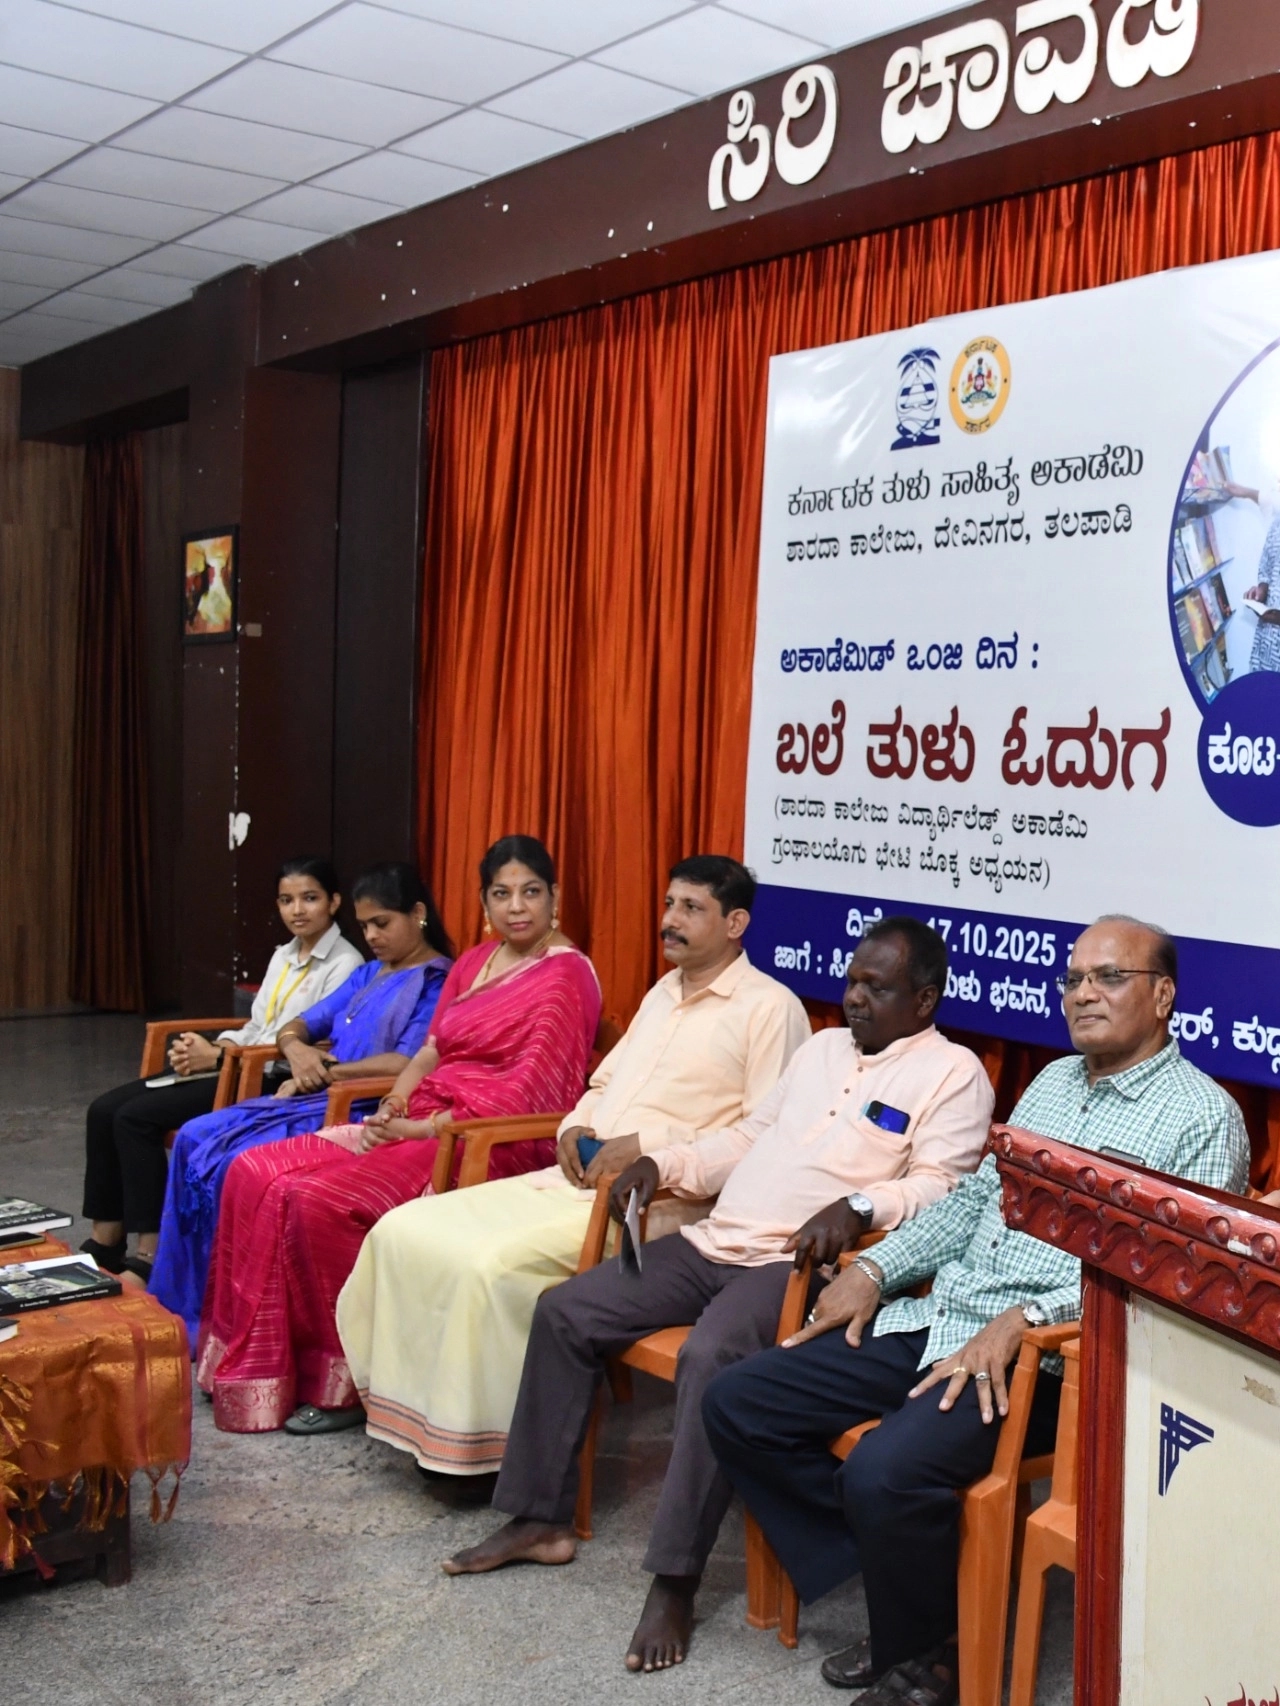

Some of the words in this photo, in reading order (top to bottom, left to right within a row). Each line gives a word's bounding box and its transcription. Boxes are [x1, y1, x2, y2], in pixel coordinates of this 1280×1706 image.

[708, 64, 838, 210] ಸಿರಿ
[788, 473, 875, 516] ಕರ್ನಾಟಕ
[882, 468, 931, 504] ತುಳು
[940, 455, 1020, 506] ಸಾಹಿತ್ಯ
[1030, 443, 1144, 486] ಅಕಾಡೆಮಿ
[786, 532, 840, 562] ಶಾರದಾ
[850, 524, 923, 554] ಕಾಲೇಜು,
[934, 510, 1031, 548] ದೇವಿನಗರ,
[1044, 503, 1132, 539] ತಲಪಾಡಿ
[780, 637, 896, 672] ಅಕಾಡೆಮಿಡ್
[907, 642, 963, 671] ಒಂಜಿ
[975, 631, 1019, 670] ದಿನ
[776, 699, 847, 777] ಬಲೆ
[866, 704, 976, 783] ತುಳು
[1001, 705, 1172, 793] ಓದುಗ
[773, 795, 826, 821] (ಶಾರದಾ
[834, 797, 889, 823] ಕಾಲೇಜು
[1011, 809, 1089, 839] ಅಕಾಡೆಮಿ
[875, 841, 911, 871] ಭೇಟಿ
[919, 846, 960, 888] ಬೊಕ್ಕ
[969, 853, 1051, 893] ಅಧ್ಯಯನ)
[774, 940, 811, 972] ಜಾಗೆ
[989, 975, 1051, 1018] ಭವನ,
